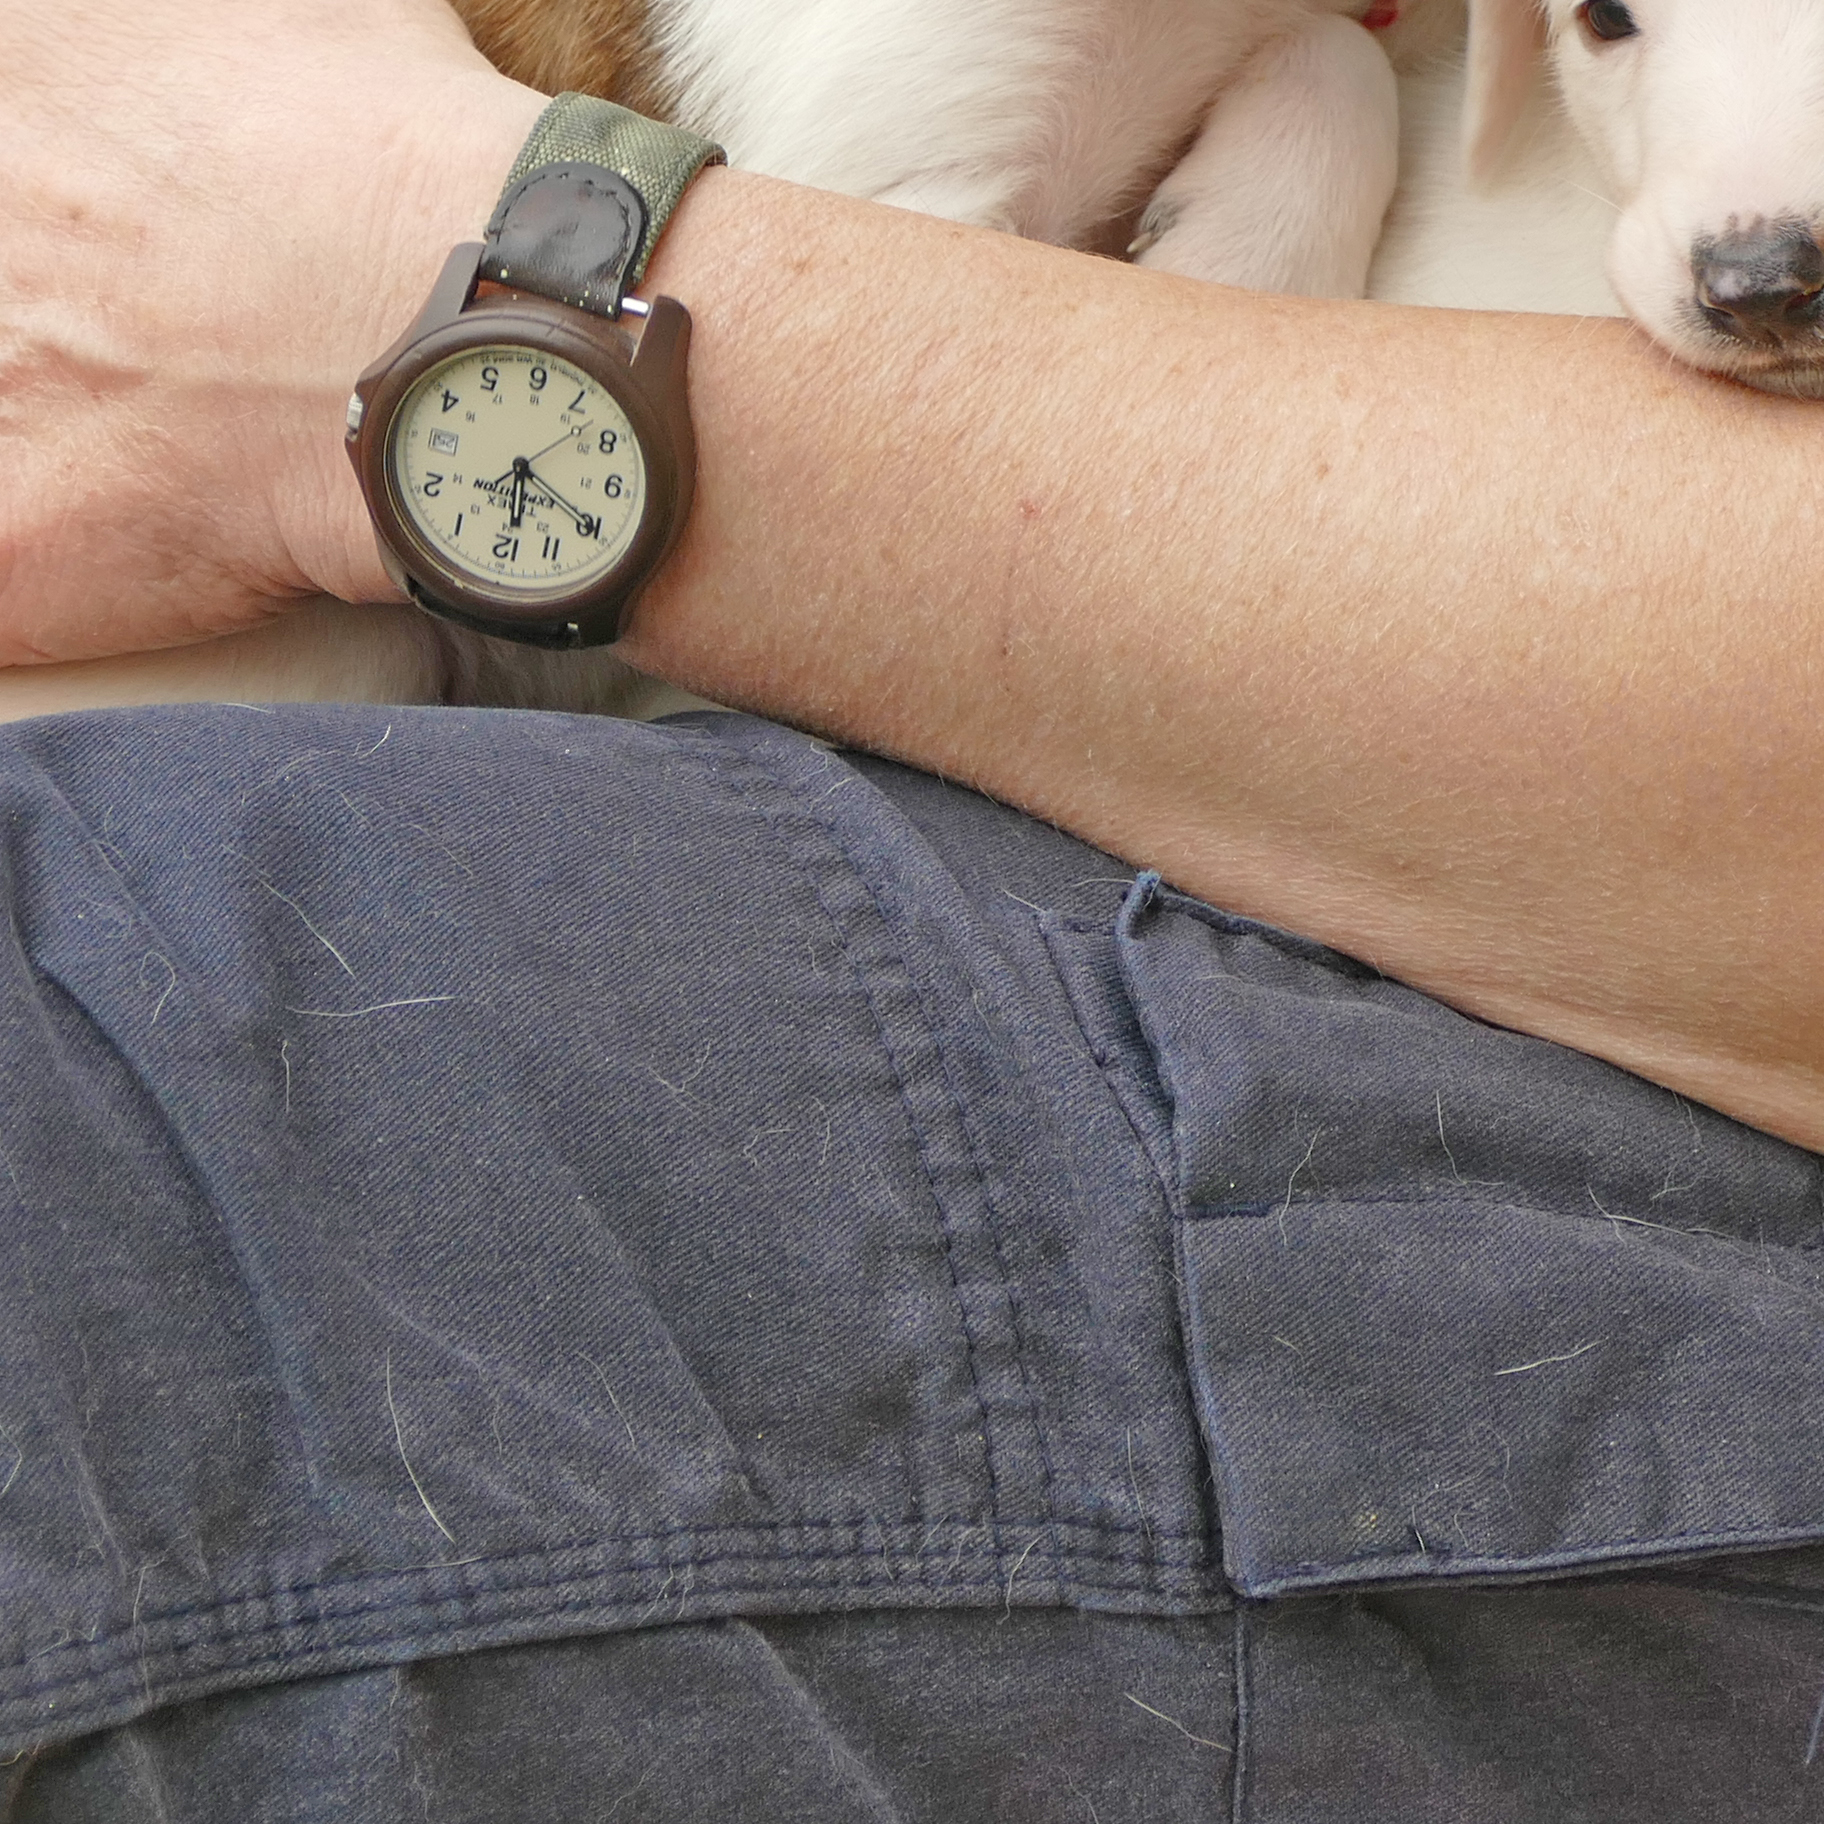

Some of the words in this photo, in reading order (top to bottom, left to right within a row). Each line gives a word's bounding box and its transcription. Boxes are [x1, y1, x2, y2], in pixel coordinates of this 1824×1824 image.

[481, 366, 499, 391] 5
[529, 367, 548, 390] 6
[440, 389, 459, 412] 4
[568, 390, 586, 414] 7
[599, 430, 617, 454] 8
[424, 472, 443, 497] 2
[604, 475, 623, 498] 9
[487, 495, 537, 517] TIEX
[454, 512, 463, 537] 1
[576, 513, 603, 540] 10
[492, 533, 520, 561] 12
[542, 536, 560, 560] 11
